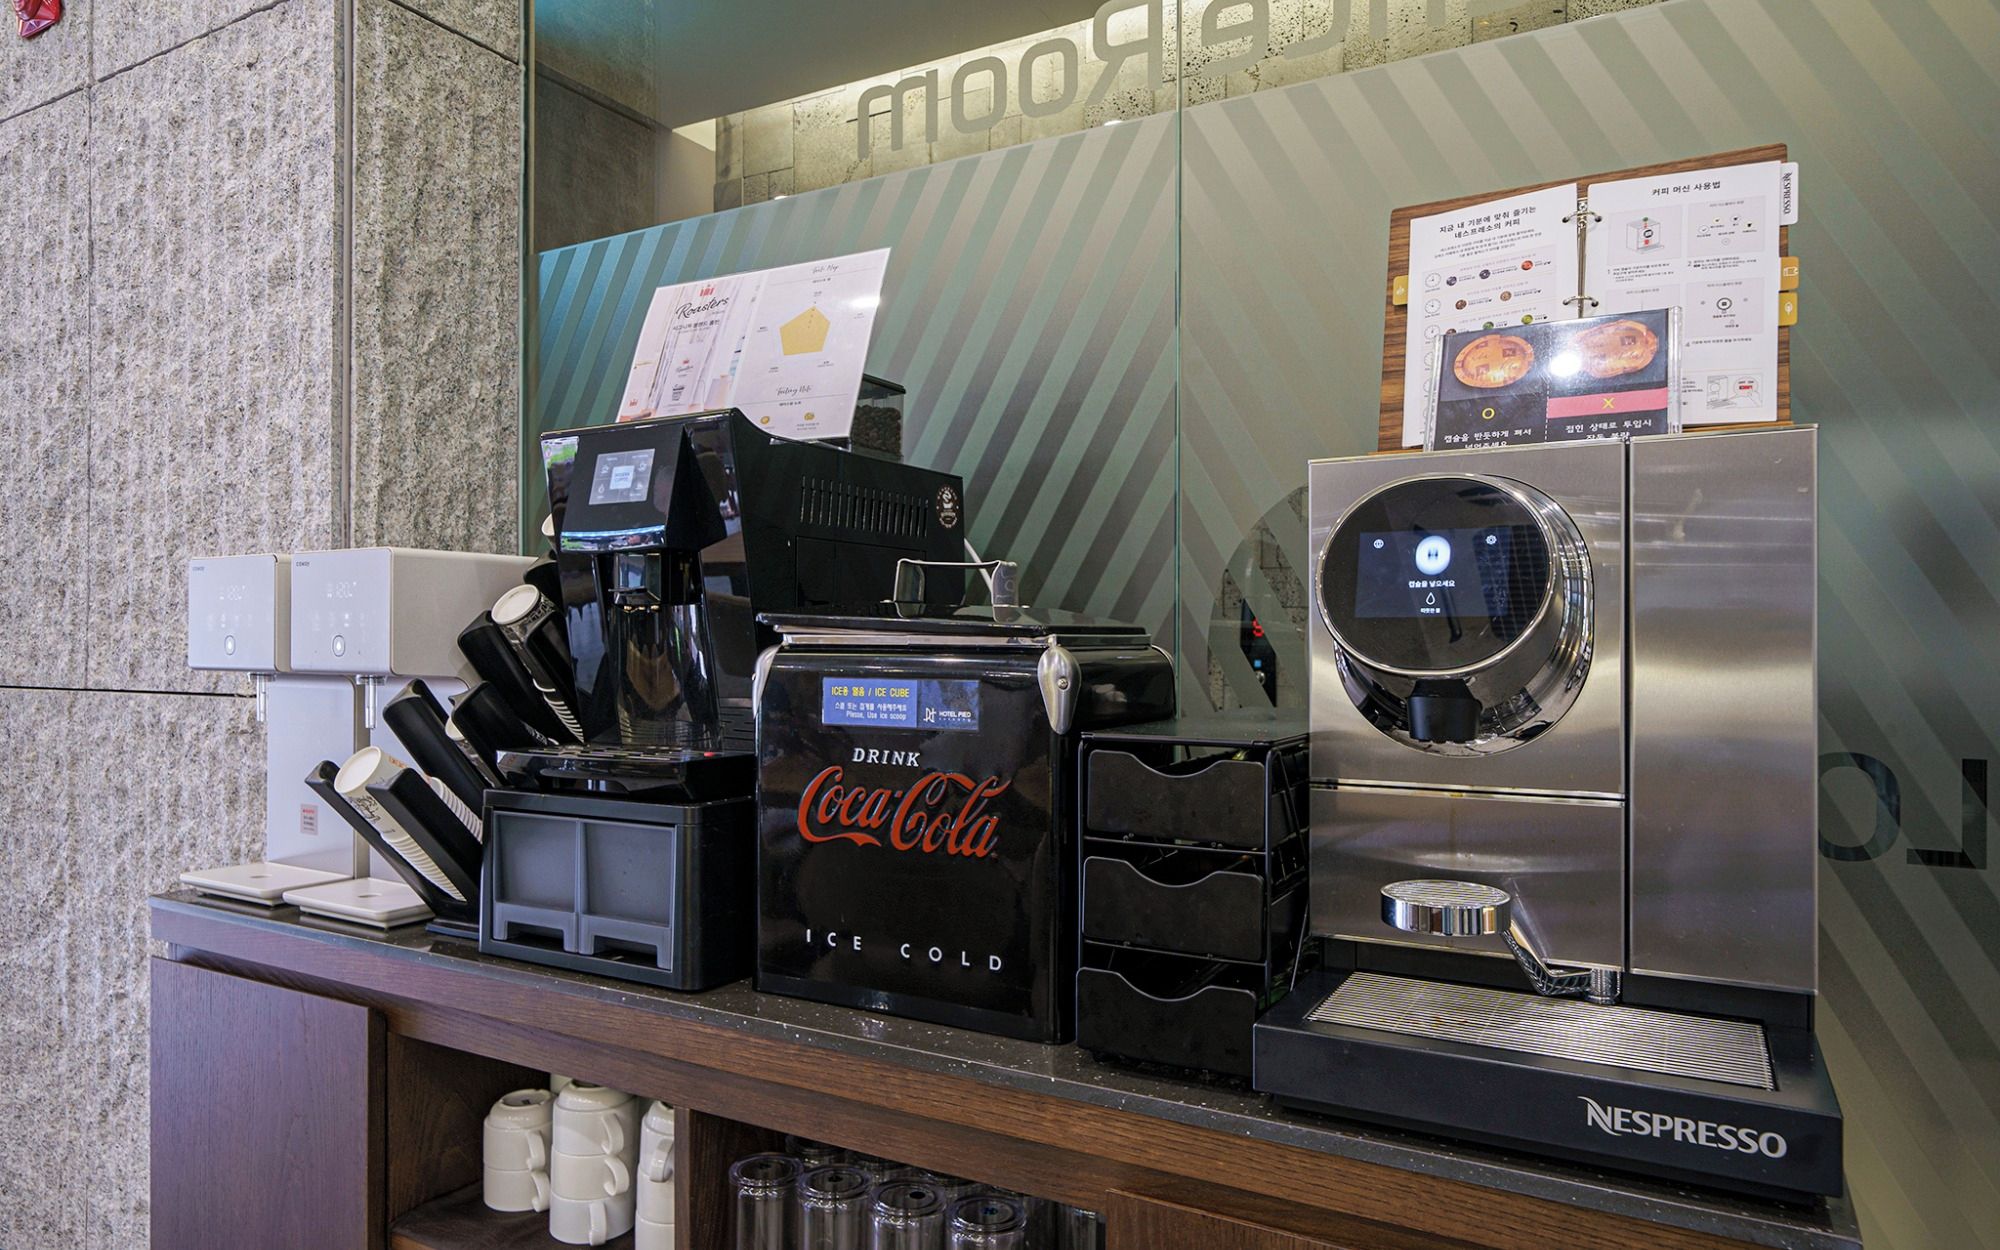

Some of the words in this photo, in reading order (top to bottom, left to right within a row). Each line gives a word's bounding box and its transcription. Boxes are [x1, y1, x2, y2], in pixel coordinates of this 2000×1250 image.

[1652, 187, 1669, 196] 커피
[1694, 181, 1721, 192] 사용법
[1782, 172, 1792, 214] NESPRESSO
[1505, 218, 1520, 228] 커피
[675, 297, 729, 319] Roasters
[875, 687, 886, 697] ICE
[890, 687, 910, 698] CUBE
[852, 748, 921, 767] DRINK
[797, 765, 1011, 858] Coca-Cola
[806, 928, 862, 951] ICE
[900, 943, 1002, 971] COLD
[1577, 1095, 1788, 1159] NESPRESSO
